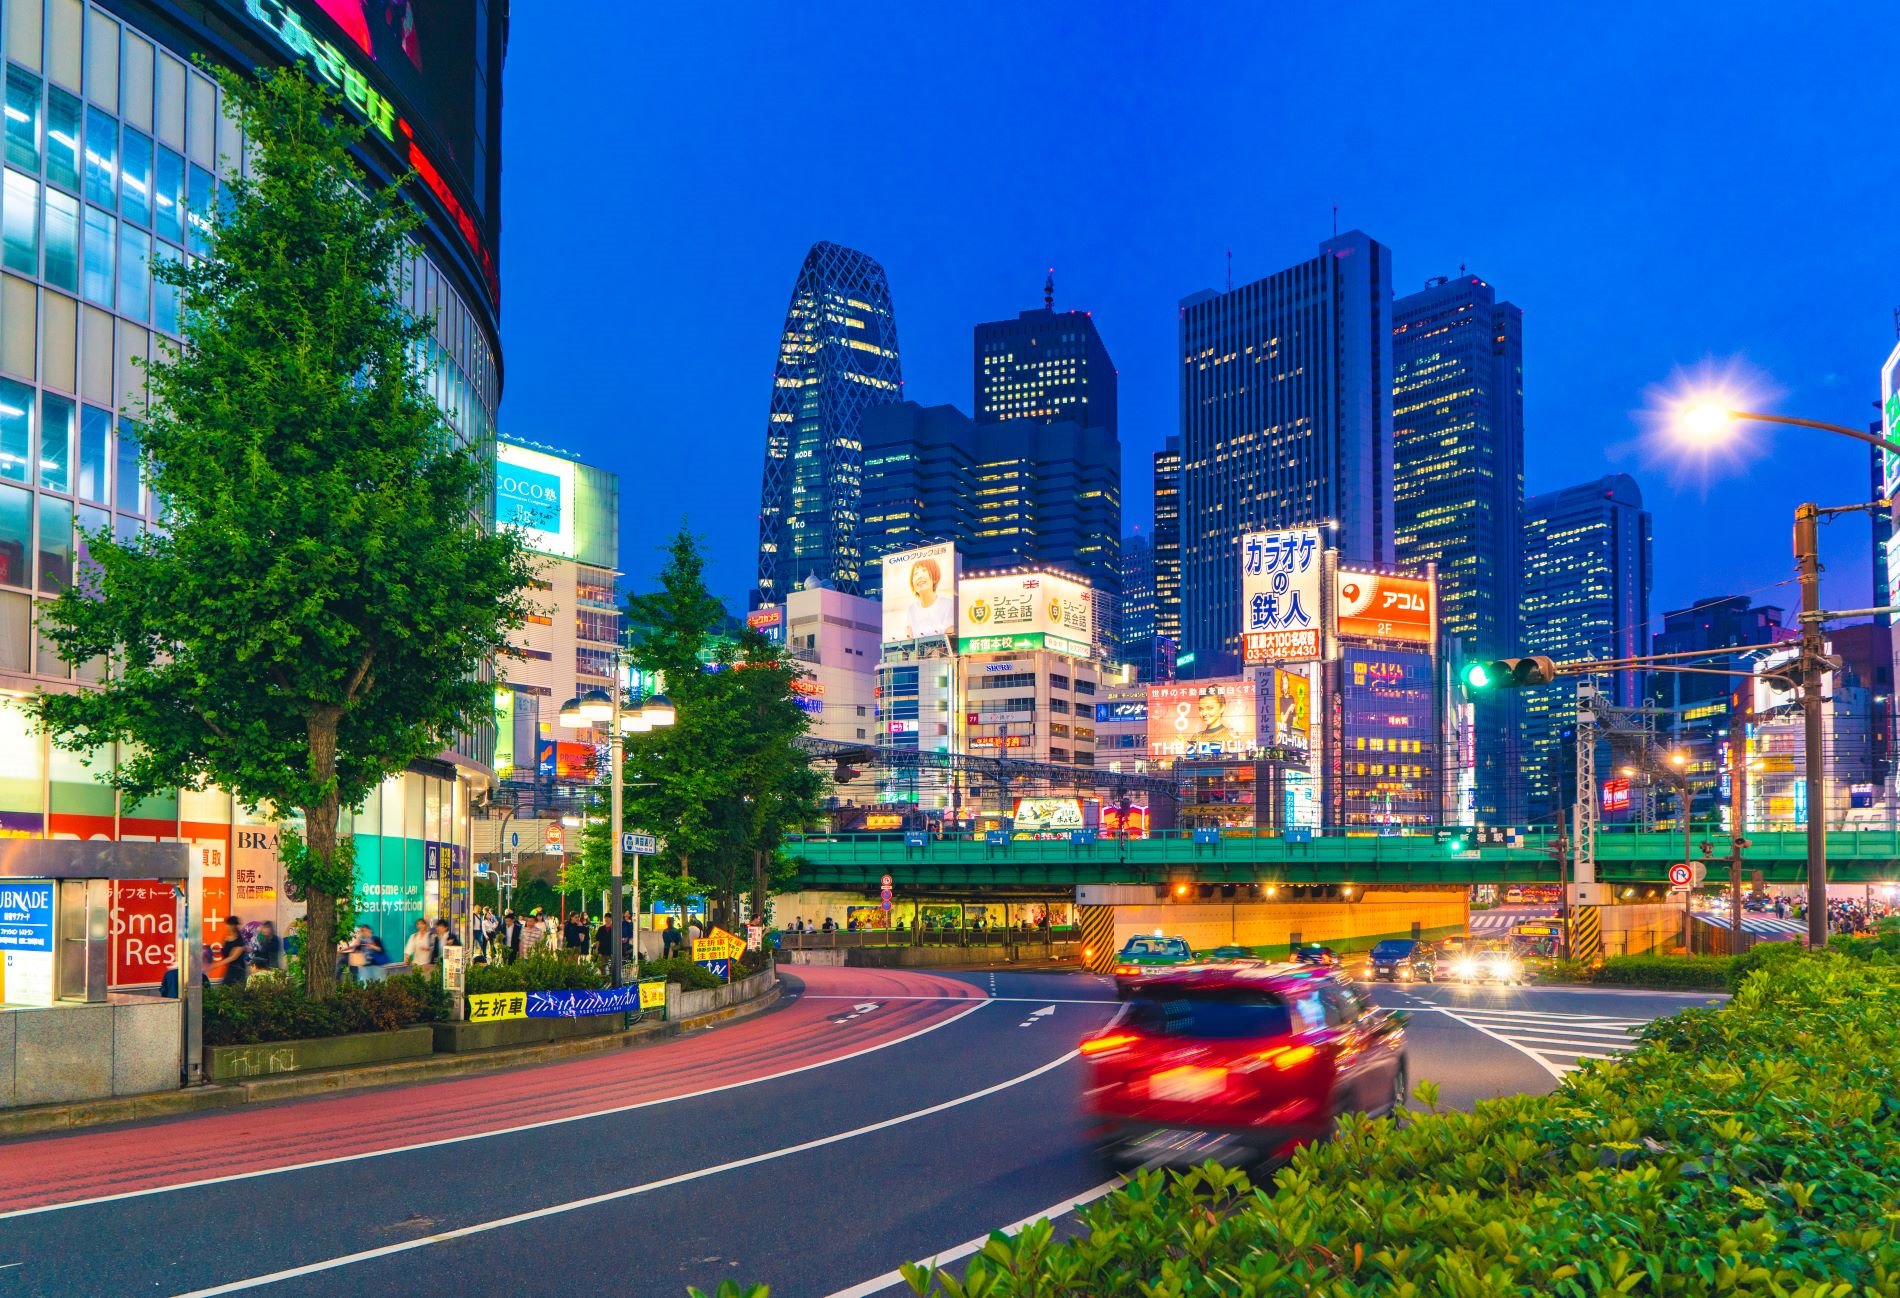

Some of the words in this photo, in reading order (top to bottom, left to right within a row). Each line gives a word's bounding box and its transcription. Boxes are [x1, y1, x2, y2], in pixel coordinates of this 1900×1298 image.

[794, 450, 813, 460] MODE
[792, 485, 807, 495] HAL
[1246, 531, 1317, 576] カラオケ
[1272, 569, 1289, 594] の
[994, 594, 1032, 607] シェーン
[1383, 591, 1425, 611] アコム
[994, 605, 1033, 620] 英会話
[1250, 590, 1312, 629] 鉄人
[1378, 623, 1392, 634] 2F
[970, 637, 1013, 651] 新宿本校
[1246, 646, 1317, 660] 03-3345-6430
[1260, 680, 1270, 733] グローバル社
[1603, 788, 1628, 804] Paoma
[363, 883, 399, 895] @cosme
[474, 997, 524, 1018] 左折車
